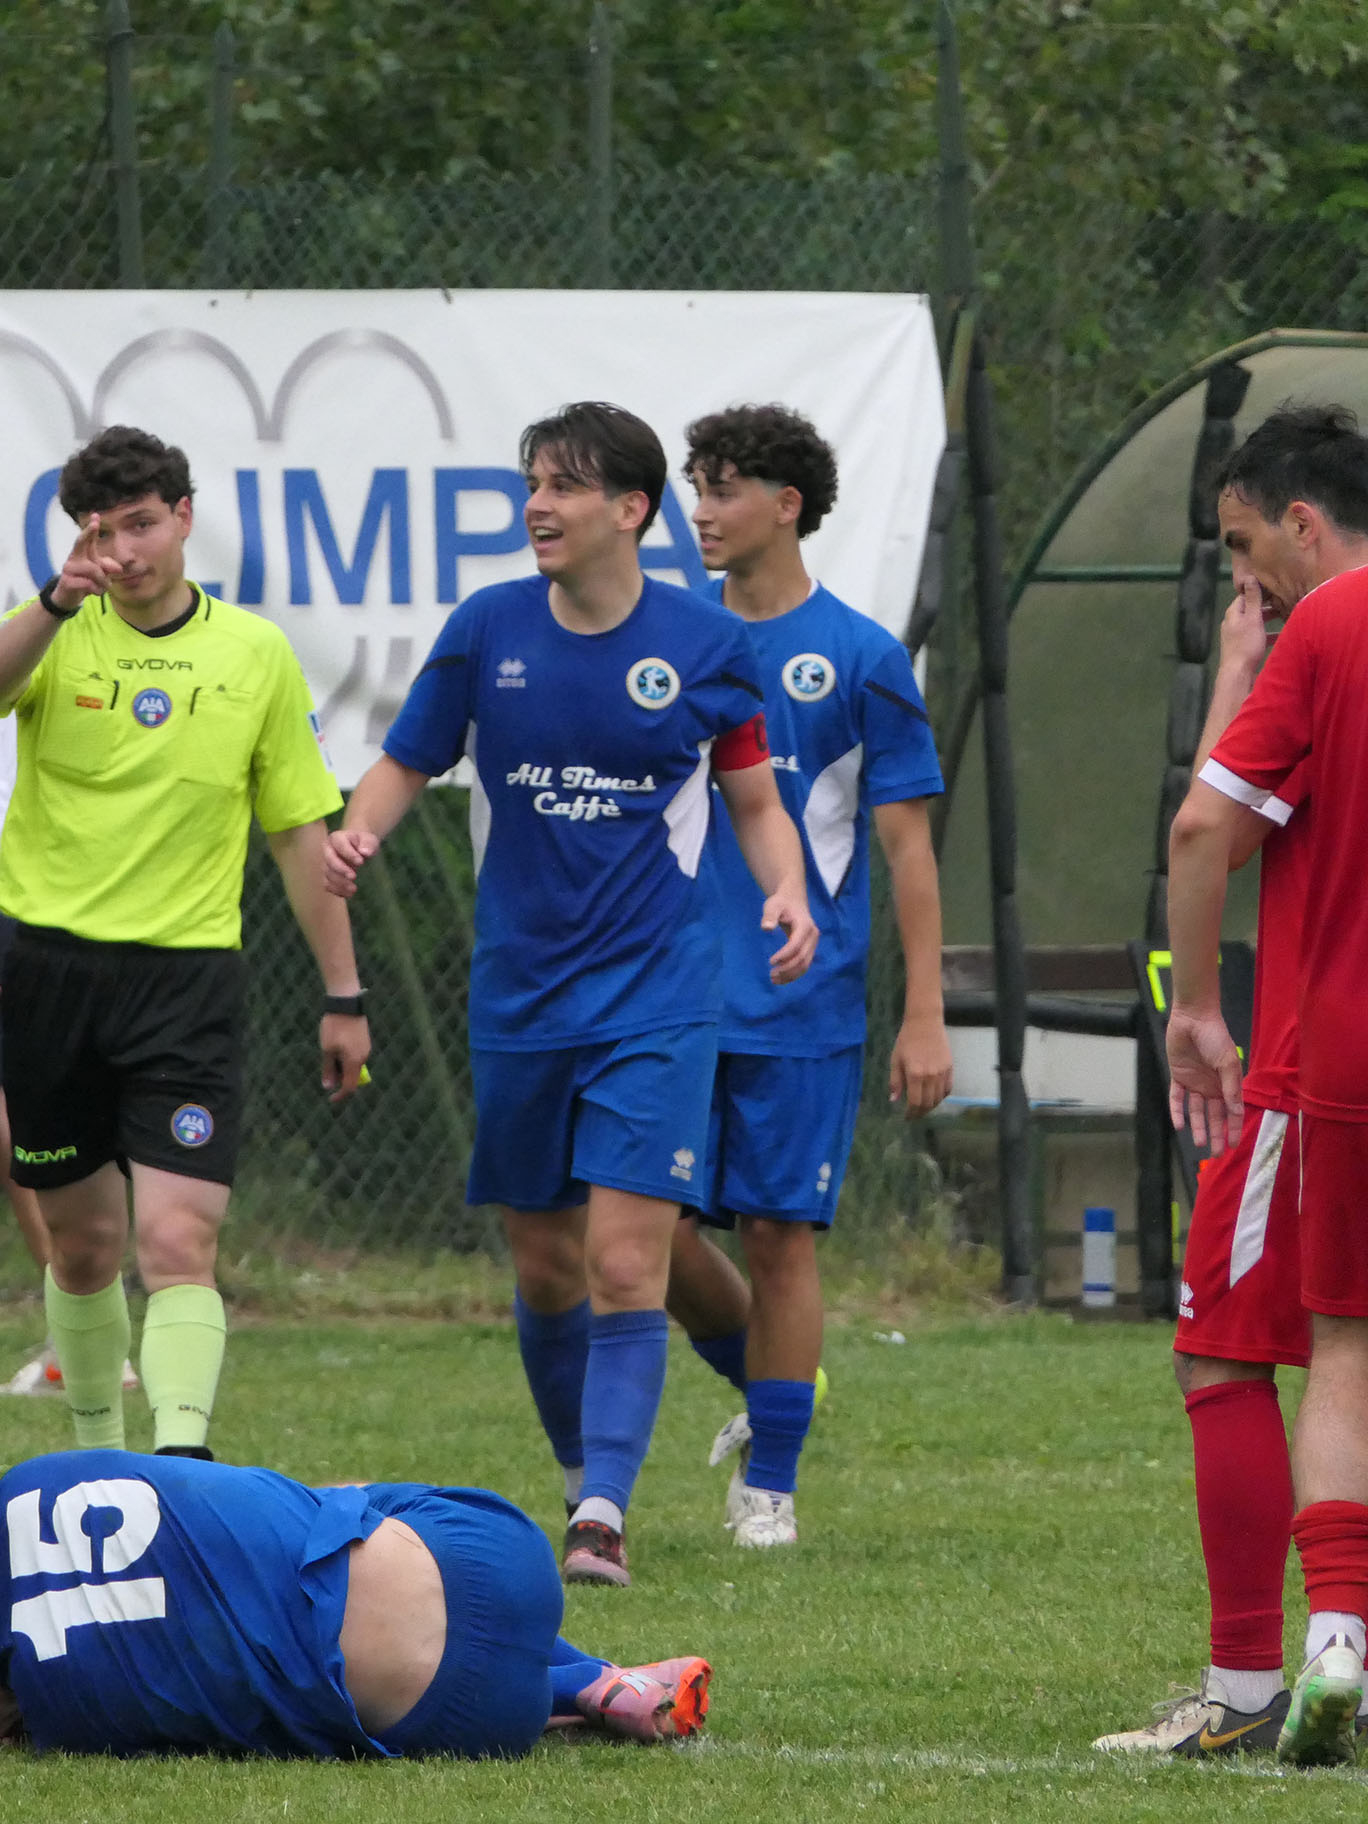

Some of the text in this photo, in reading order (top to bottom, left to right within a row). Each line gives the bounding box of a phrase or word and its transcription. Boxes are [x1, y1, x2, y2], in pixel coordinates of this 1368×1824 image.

[24, 467, 712, 605] IMPA
[506, 763, 657, 792] All Times
[6, 1479, 166, 1662] 15
